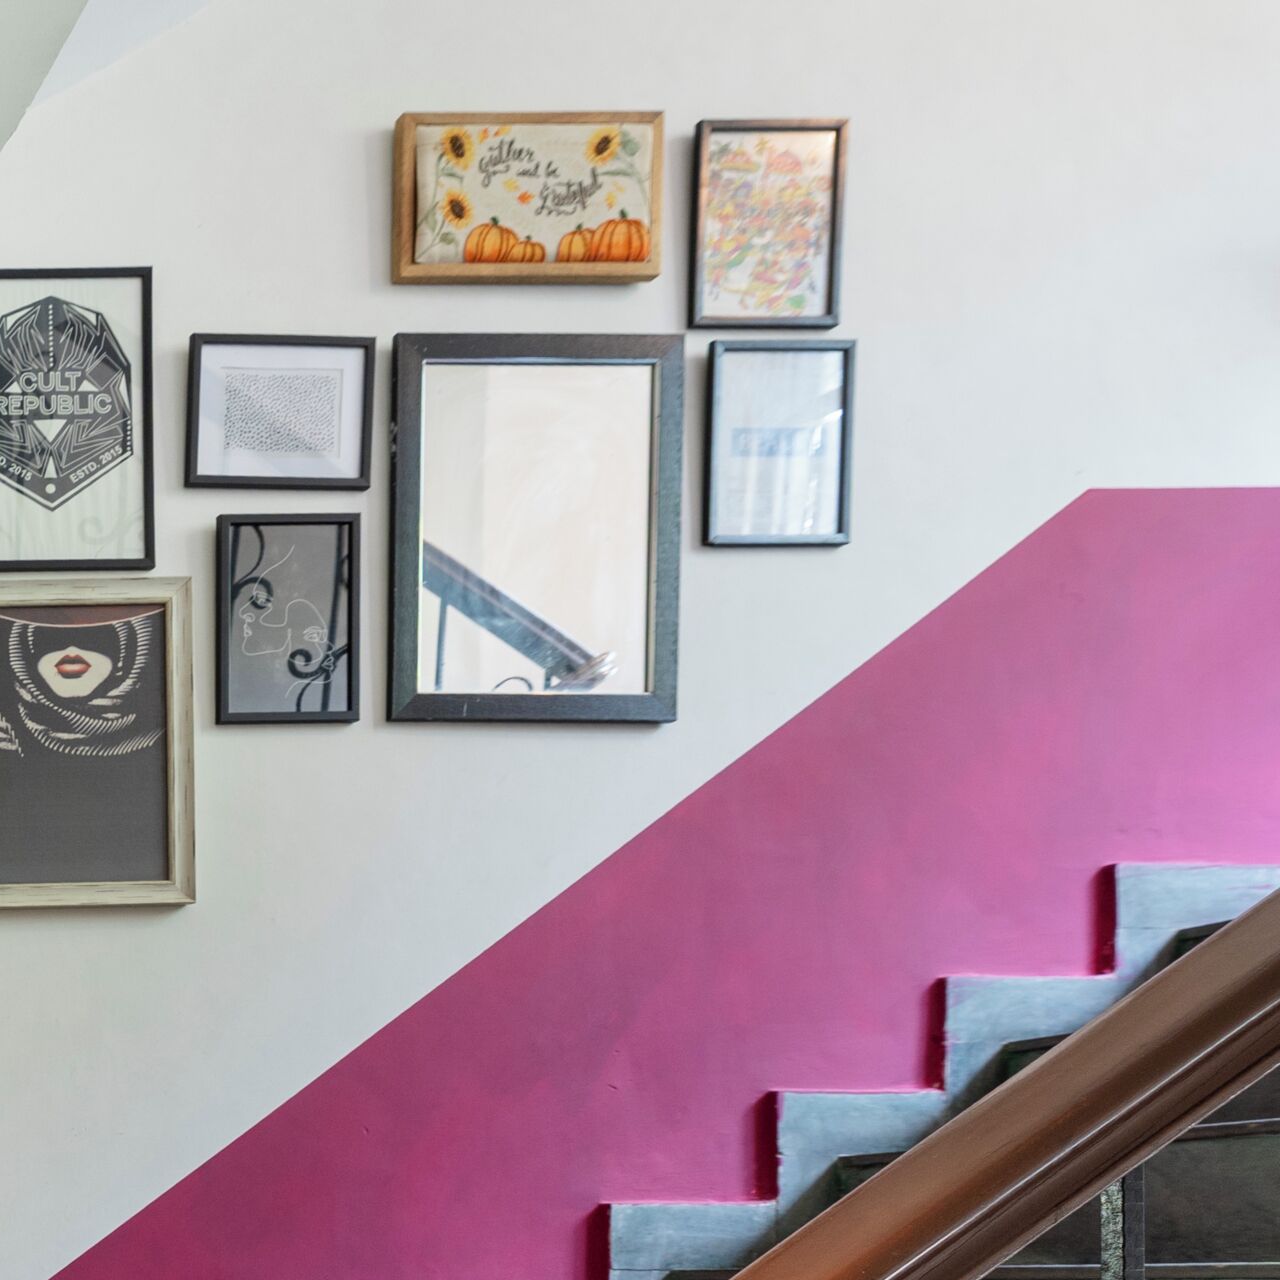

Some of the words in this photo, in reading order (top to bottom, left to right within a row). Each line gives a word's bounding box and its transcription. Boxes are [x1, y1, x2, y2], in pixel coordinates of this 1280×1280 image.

[516, 161, 540, 178] and
[545, 160, 560, 178] be
[20, 371, 81, 392] CULT
[9, 463, 32, 481] 2015
[69, 460, 99, 483] ESTD.
[99, 445, 123, 465] 2015
